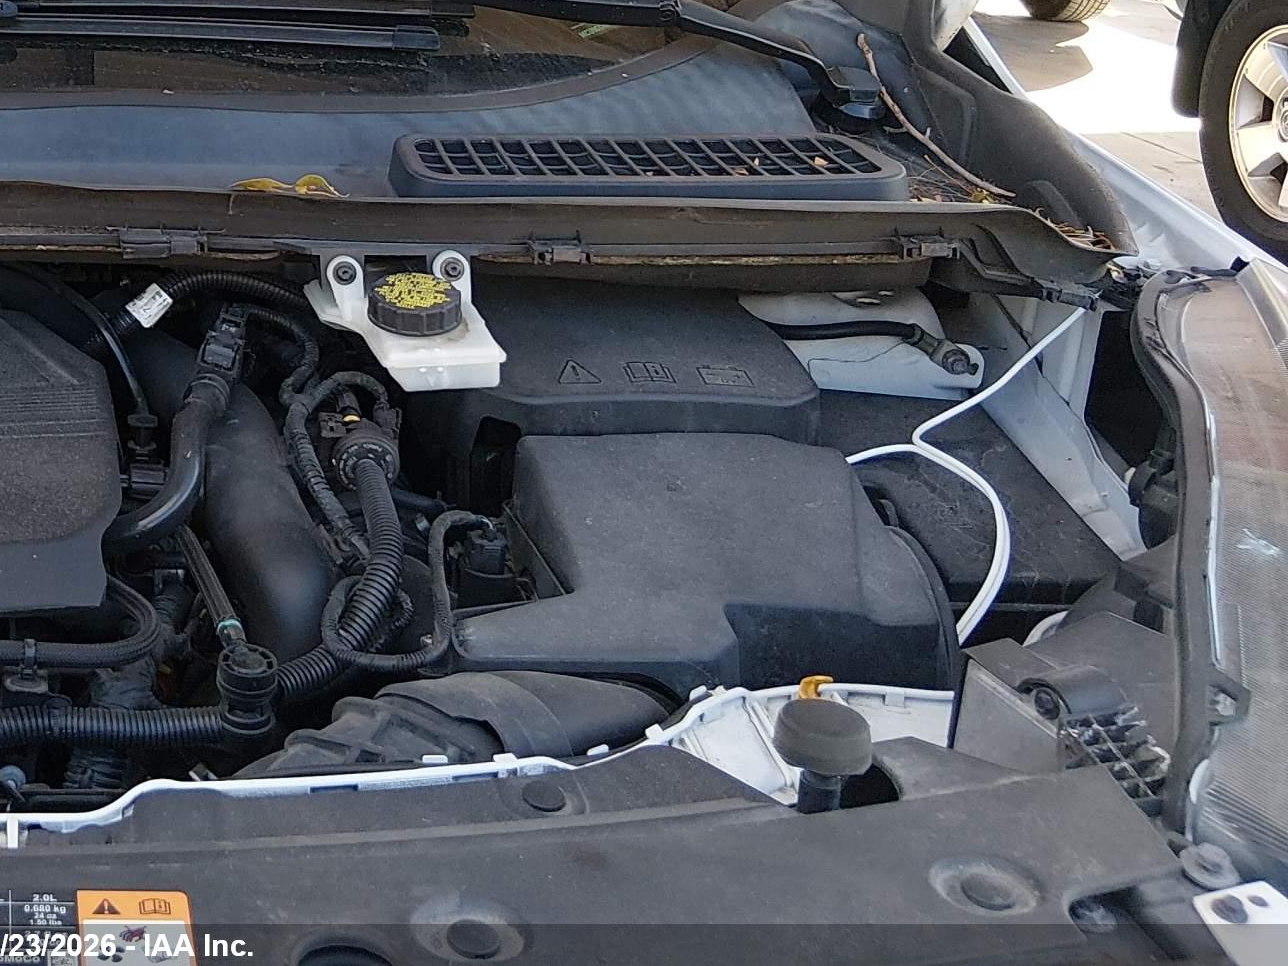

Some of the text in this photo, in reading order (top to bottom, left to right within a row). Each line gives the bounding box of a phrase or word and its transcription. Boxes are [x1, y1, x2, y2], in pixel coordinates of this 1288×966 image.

[32, 893, 57, 902] 2.0L
[23, 903, 67, 914] 0.680 kg
